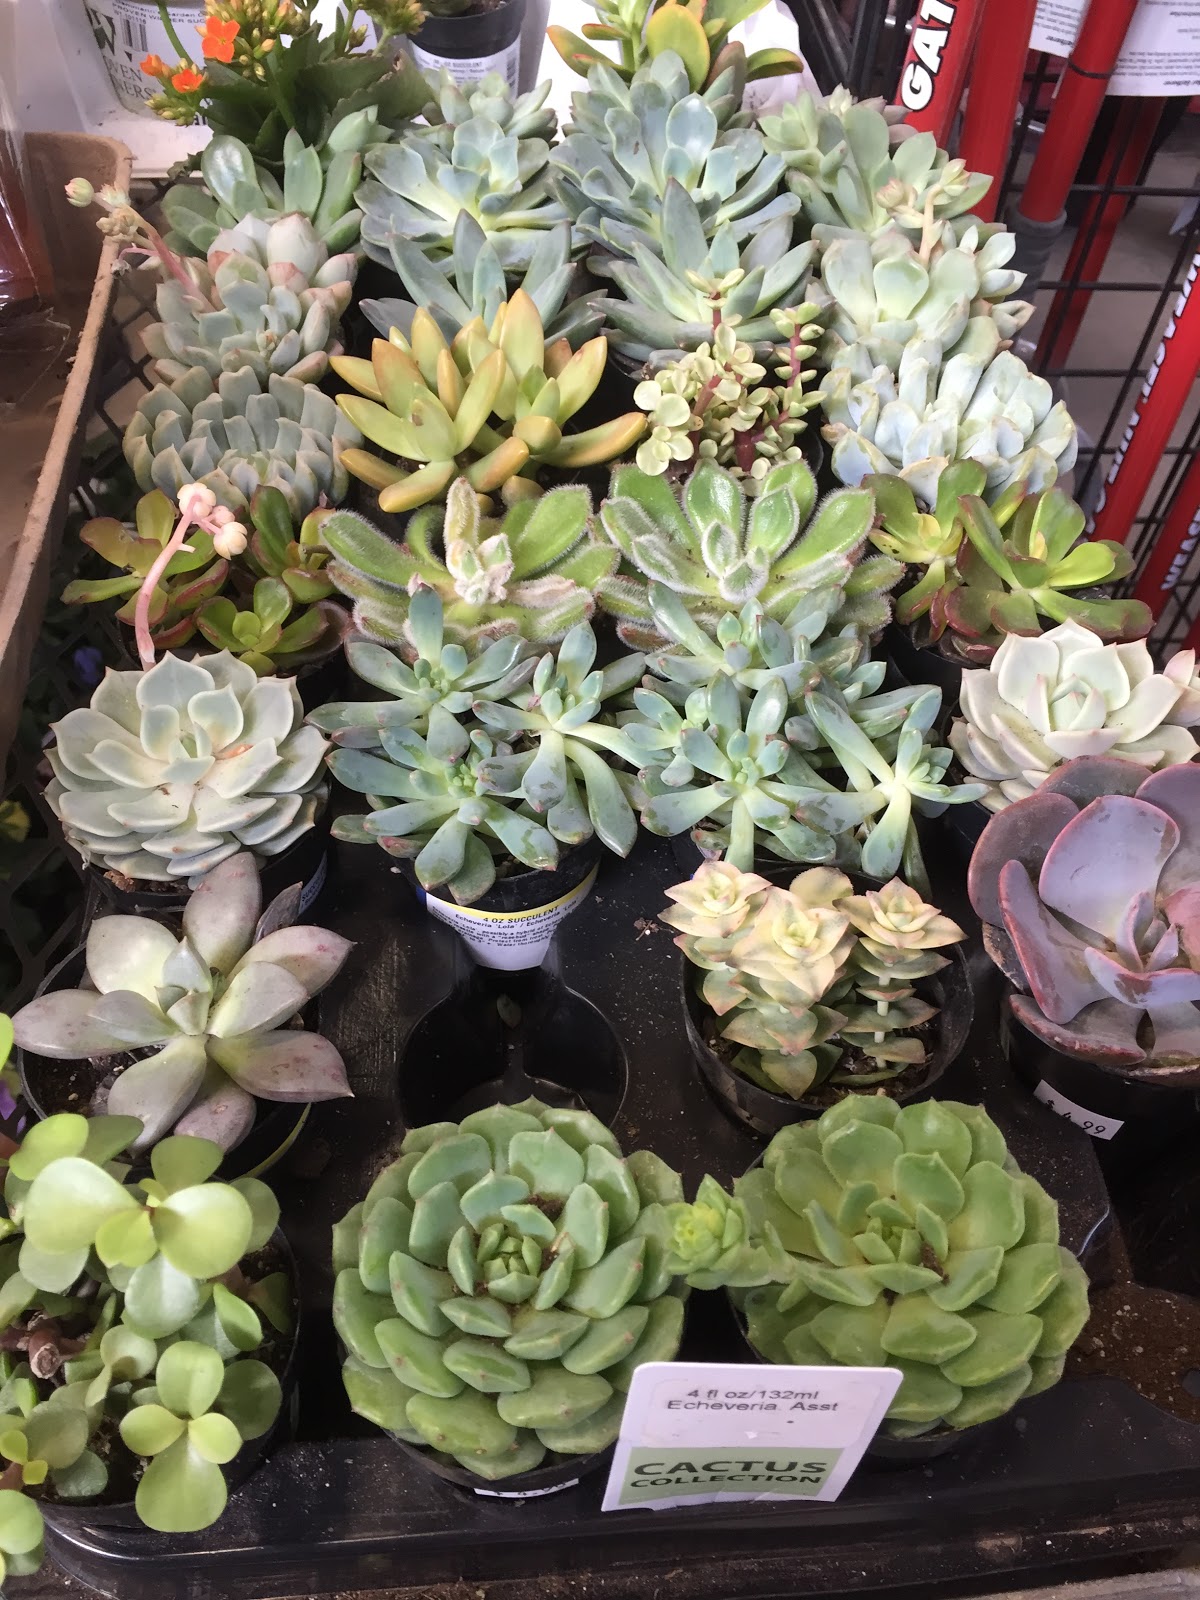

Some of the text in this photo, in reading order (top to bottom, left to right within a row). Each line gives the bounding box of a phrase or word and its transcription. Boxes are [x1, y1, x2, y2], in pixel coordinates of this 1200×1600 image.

[455, 913, 492, 928] Echeveria
[507, 905, 559, 923] SUCCULENT
[687, 1389, 820, 1400] 4 fl oz/132ml
[667, 1400, 839, 1412] Echeveria Asst
[633, 1460, 829, 1477] CACTUS
[630, 1473, 823, 1489] COLLECTION
